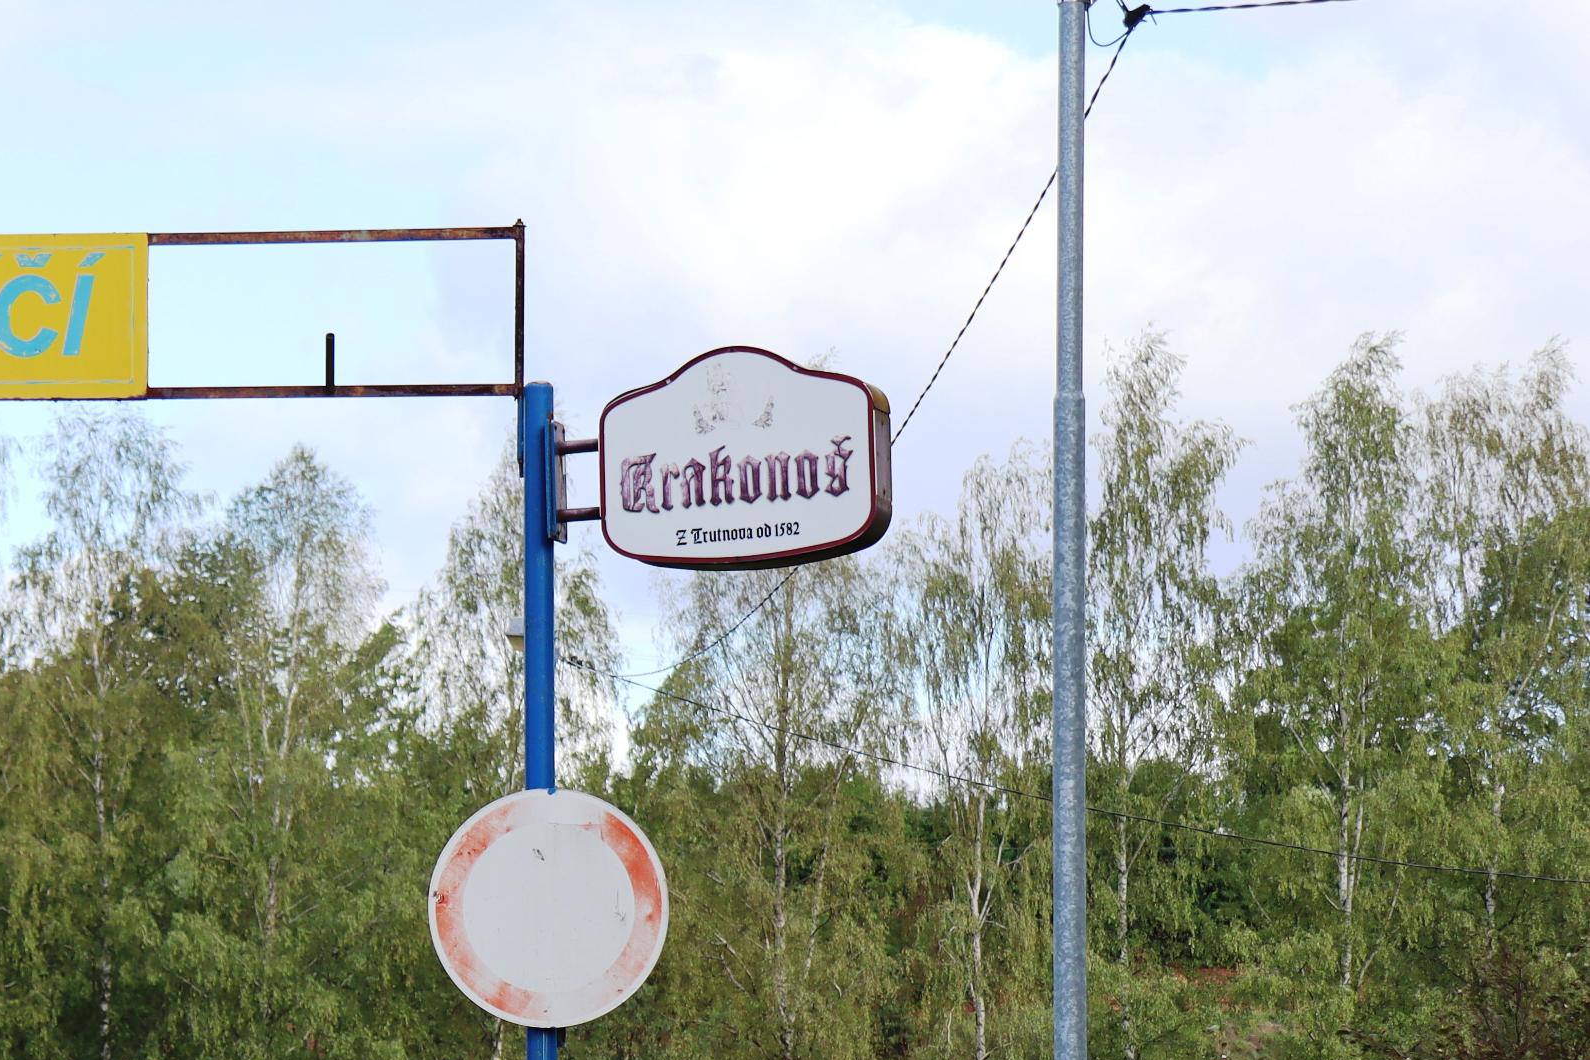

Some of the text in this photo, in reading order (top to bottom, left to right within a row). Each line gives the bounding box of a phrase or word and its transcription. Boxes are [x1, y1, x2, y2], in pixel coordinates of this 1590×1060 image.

[620, 435, 854, 514] Krakonoš
[691, 525, 754, 545] Trutnova
[756, 524, 772, 539] od
[774, 521, 800, 537] 1582
